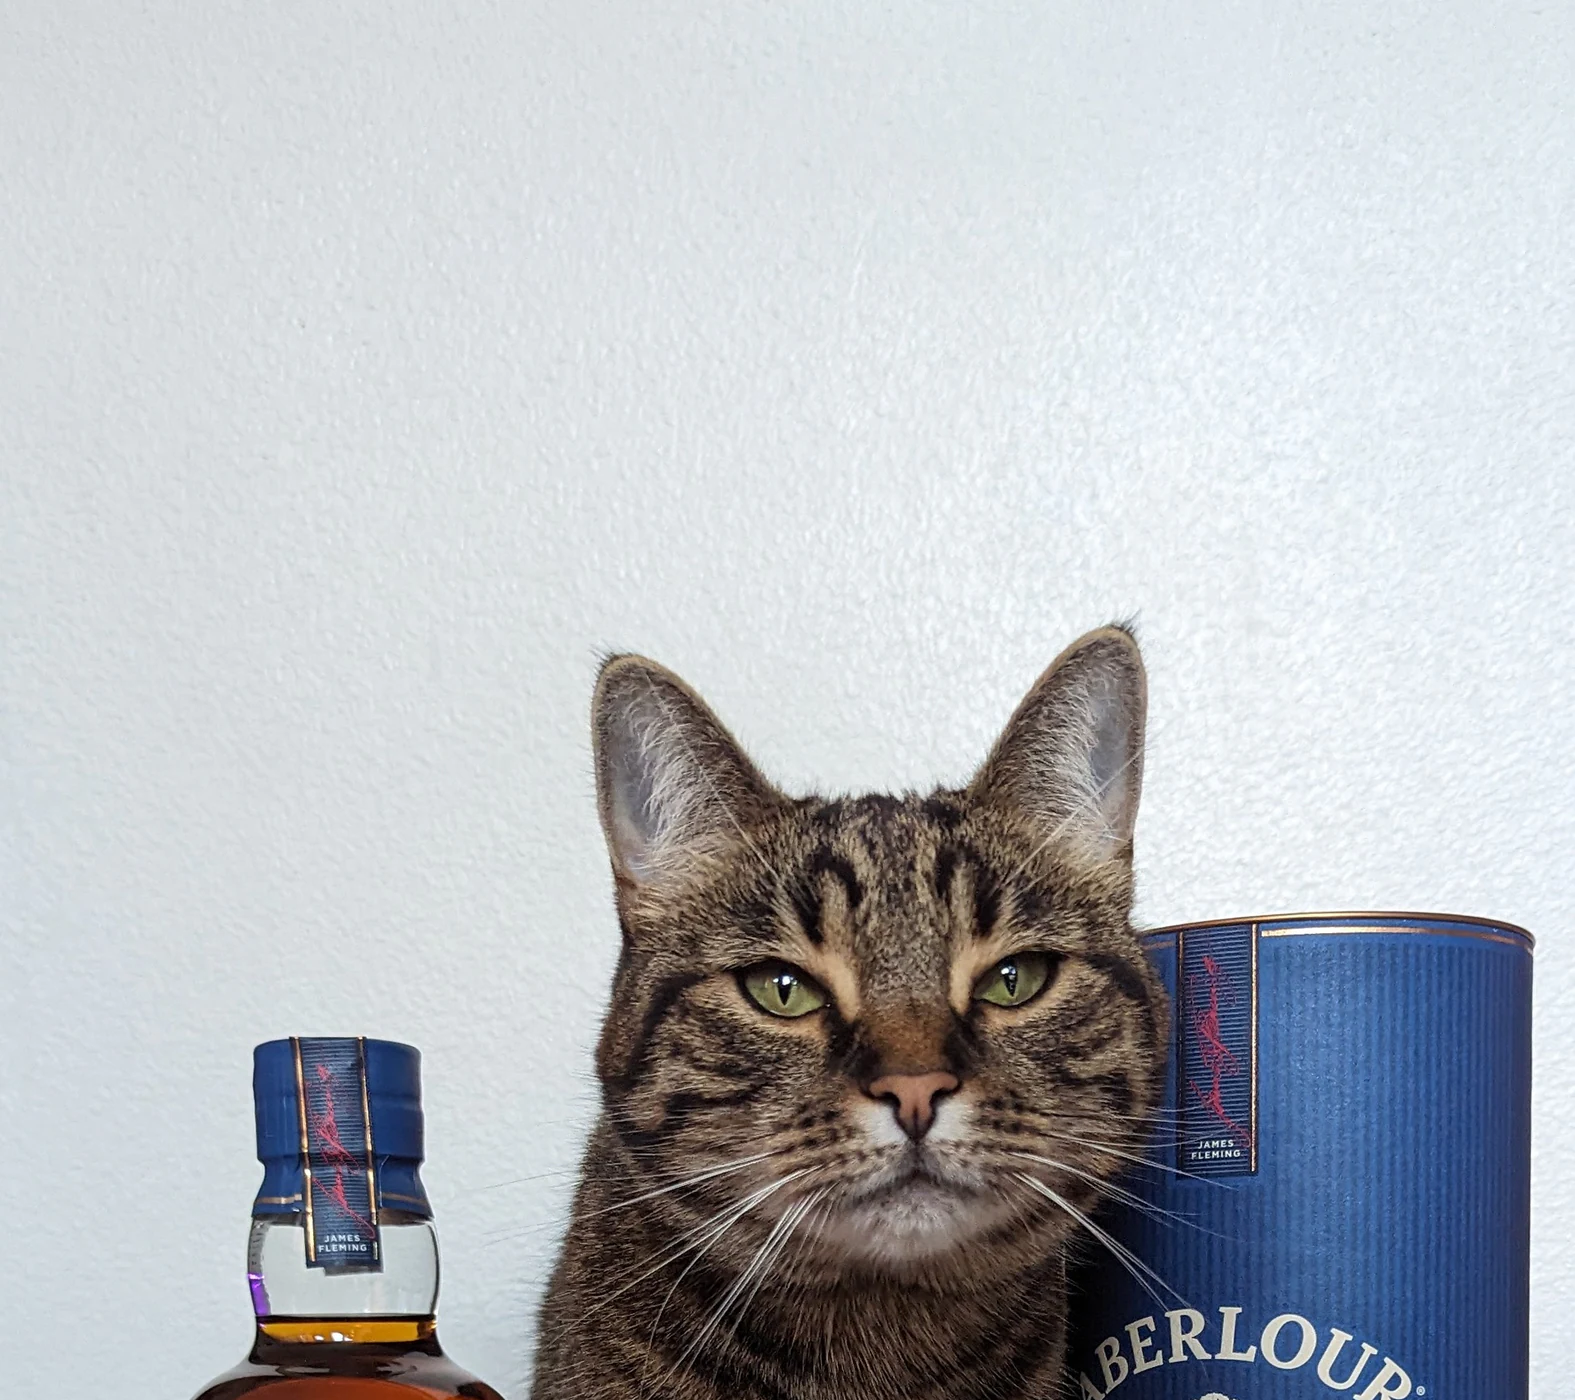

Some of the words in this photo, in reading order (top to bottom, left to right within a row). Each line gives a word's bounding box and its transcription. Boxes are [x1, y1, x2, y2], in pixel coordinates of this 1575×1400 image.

[1197, 1139, 1234, 1149] JAMES
[1191, 1149, 1241, 1160] FLEMING
[324, 1234, 361, 1242] JAMES
[318, 1244, 367, 1253] FLEMING
